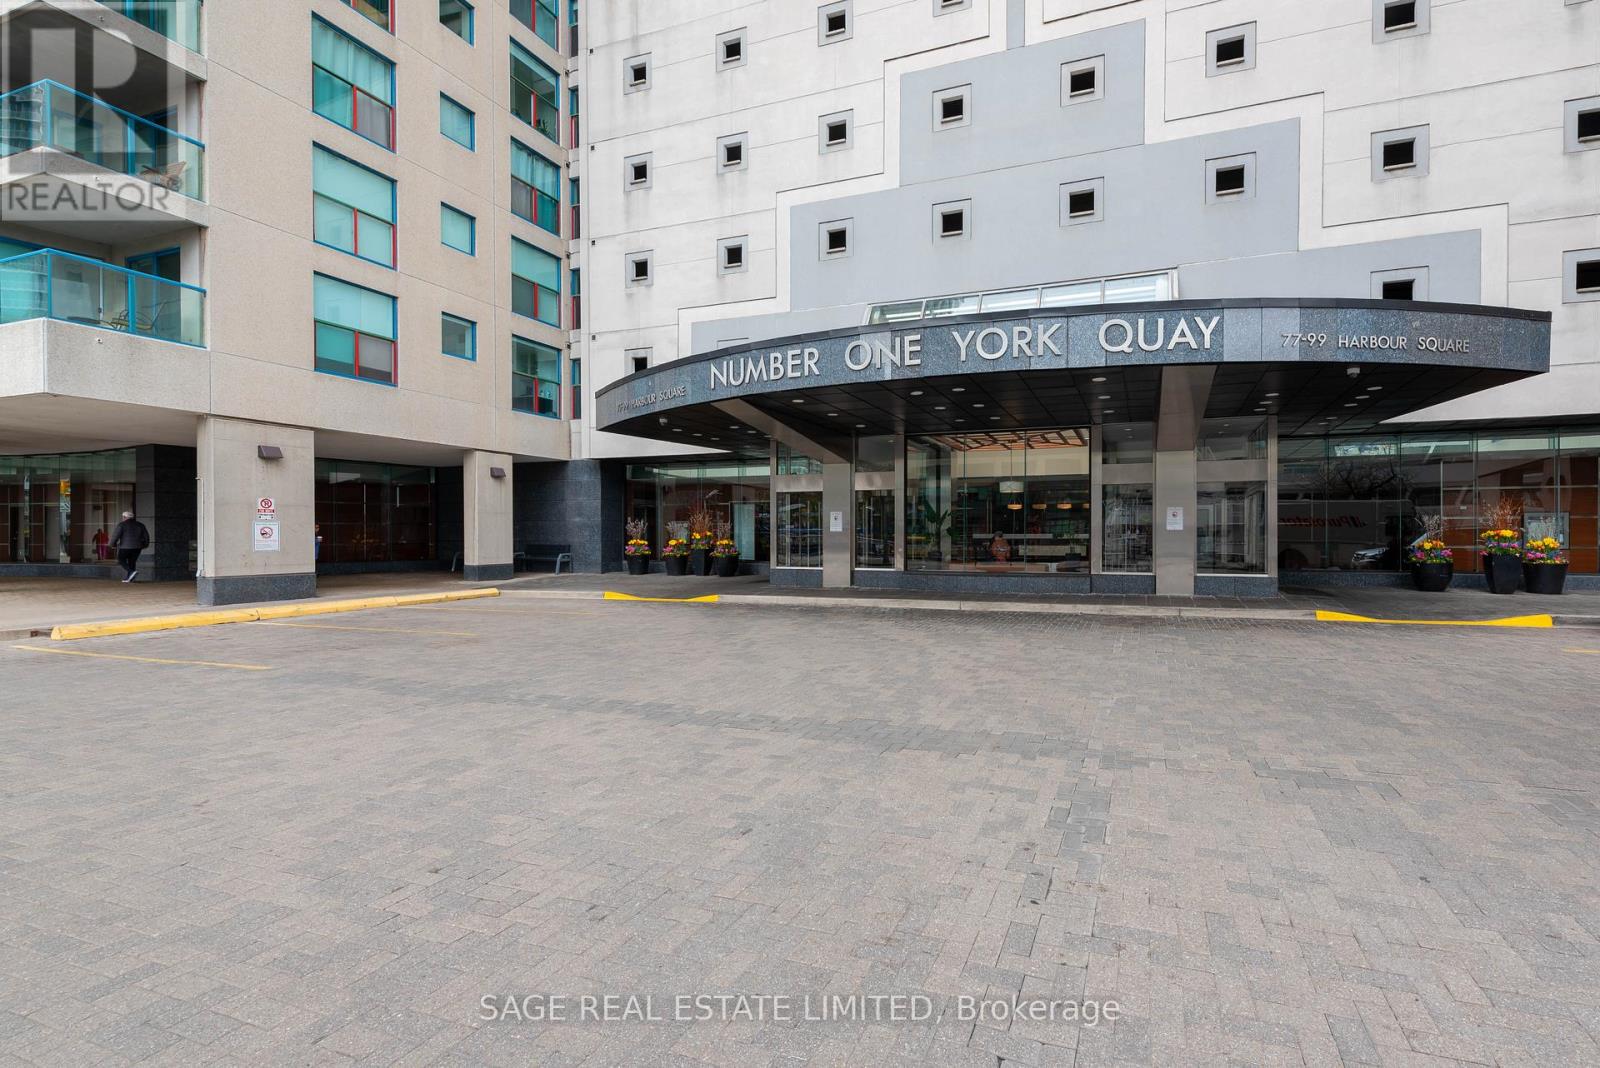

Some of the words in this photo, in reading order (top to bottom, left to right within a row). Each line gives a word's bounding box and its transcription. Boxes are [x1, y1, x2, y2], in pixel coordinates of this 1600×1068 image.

[710, 346, 820, 389] NUMBER
[844, 334, 922, 371] ONE
[951, 322, 1062, 362] YORK
[1099, 315, 1221, 353] QUAY
[1281, 333, 1327, 347] 77-99
[1338, 335, 1408, 349] HARBOUR
[1417, 336, 1470, 352] SQUARE
[659, 385, 687, 401] SQUARE
